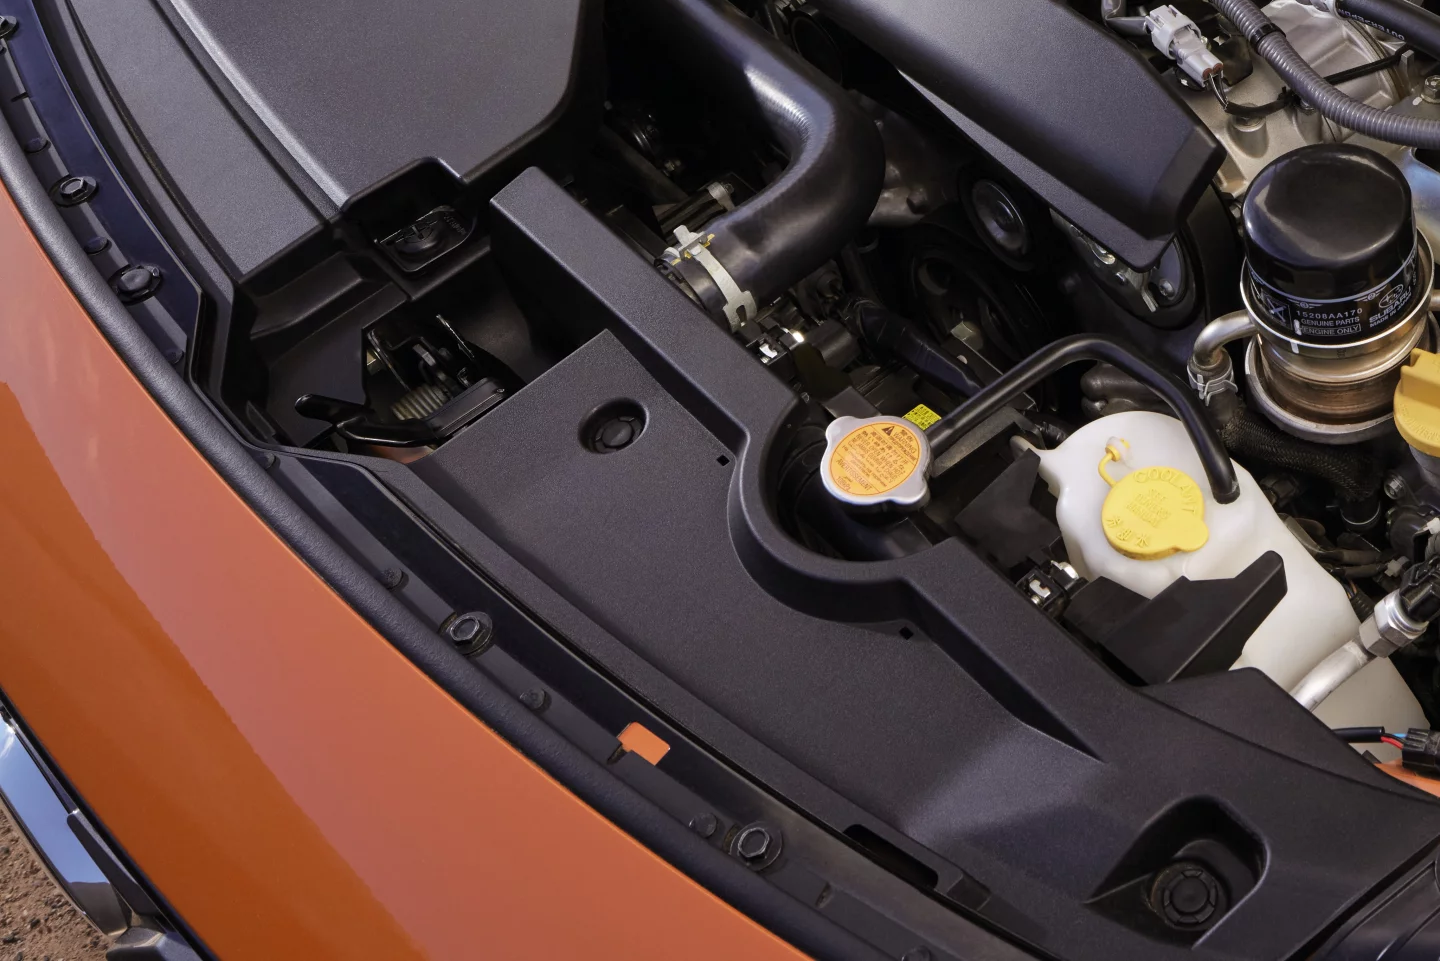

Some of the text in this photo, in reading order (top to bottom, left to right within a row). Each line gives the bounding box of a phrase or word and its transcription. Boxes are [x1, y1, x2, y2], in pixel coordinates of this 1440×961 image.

[1295, 308, 1363, 320] 15208AA170
[1369, 285, 1412, 324] SUBARU
[1301, 316, 1360, 327] GENUINE PARTS
[1303, 326, 1359, 335] ENGINE ONLY
[1369, 315, 1389, 327] MADE
[856, 434, 869, 446] NEVER
[868, 445, 880, 456] OPEN
[880, 455, 893, 468] WHEN
[893, 432, 916, 453] WARNING
[836, 458, 872, 491] AVERTISSEMENT
[1133, 468, 1197, 516] COOLANT
